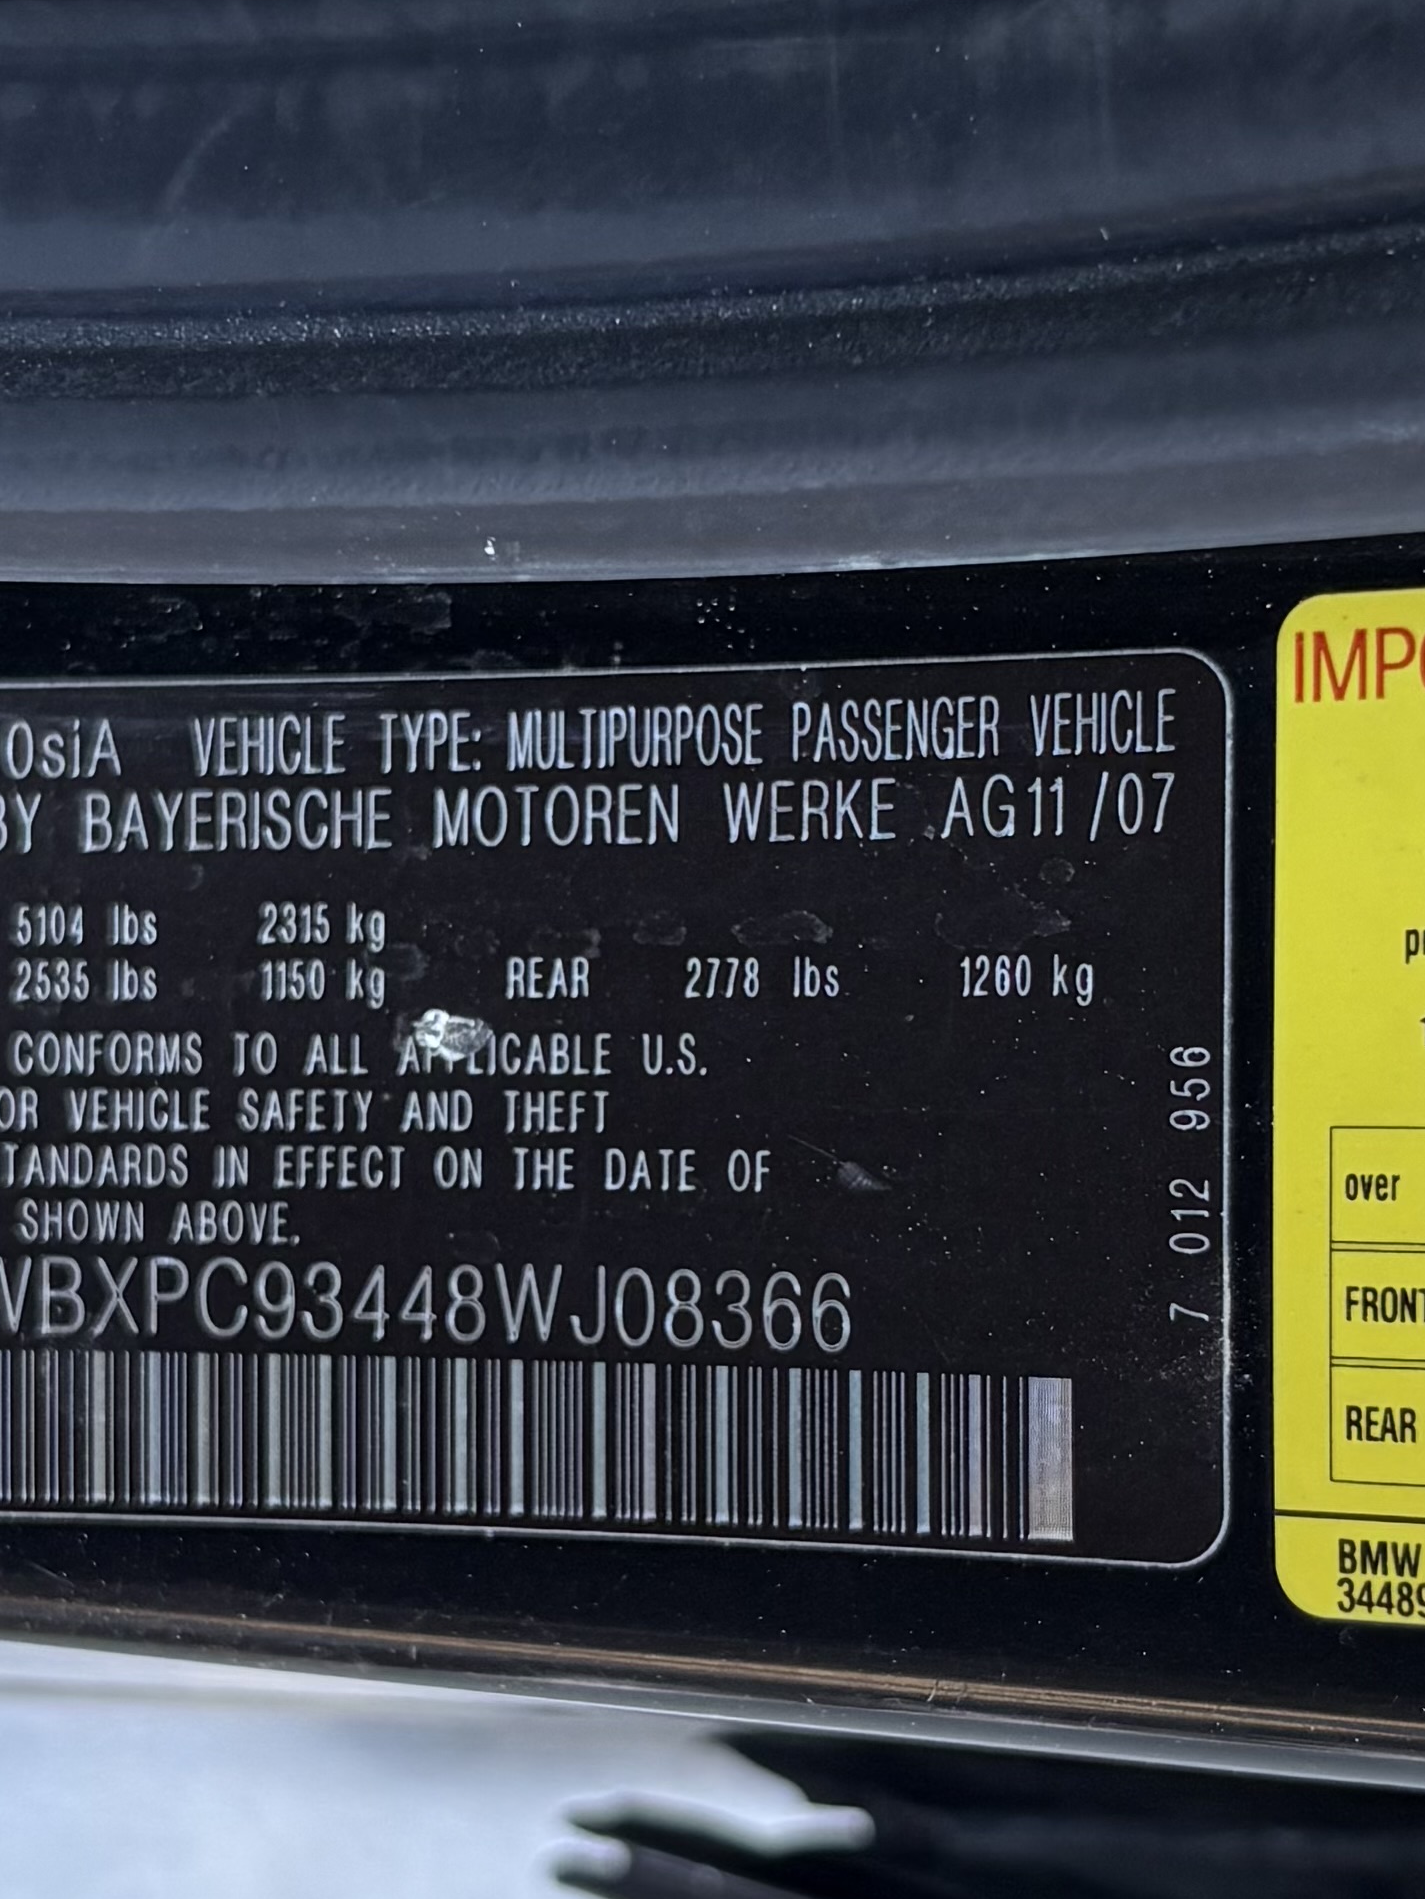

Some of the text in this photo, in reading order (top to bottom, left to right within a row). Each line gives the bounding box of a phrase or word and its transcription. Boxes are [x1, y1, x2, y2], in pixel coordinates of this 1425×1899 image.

[194, 714, 346, 777] VEHICLE
[379, 711, 481, 773] TYPE:
[508, 703, 764, 772] MULTIPURPOSE
[792, 695, 1000, 763] PASSENGER
[1030, 688, 1176, 757] VEHICLE
[83, 788, 392, 853] BAYERISCHE
[433, 783, 679, 849] MOTOREN
[723, 777, 896, 844] WERKE
[16, 905, 84, 946] 5104
[113, 904, 157, 945] lbs
[261, 903, 330, 945] 2315
[349, 902, 385, 953] kg
[15, 959, 90, 1002] 2535
[112, 960, 157, 1001] lbs
[263, 959, 325, 1001] 1150
[349, 959, 385, 1009] kg
[506, 956, 589, 1000] REAR
[684, 956, 760, 999] 2778
[793, 956, 840, 998] lbs
[960, 954, 1032, 998] 1260
[1052, 953, 1094, 1007] kg
[14, 1032, 203, 1075] CONFORMS
[235, 1032, 277, 1076] TO
[305, 1034, 369, 1076] ALL
[642, 1032, 707, 1076] U.S.
[70, 1088, 210, 1131] VEHICLE
[240, 1088, 373, 1132] SAFETY
[402, 1089, 473, 1132] AND
[504, 1090, 609, 1134] THEFT
[217, 1146, 249, 1188] IN
[275, 1145, 405, 1189] EFFECT
[435, 1146, 482, 1189] ON
[514, 1147, 574, 1191] THE
[604, 1148, 696, 1192] DATE
[727, 1148, 771, 1193] OF
[1168, 1046, 1211, 1322] 7 012 956
[1345, 1173, 1401, 1202] over
[20, 1198, 144, 1243] SHOWN
[172, 1200, 300, 1244] ABOVE.
[1346, 1405, 1417, 1444] REAR
[1337, 1537, 1423, 1579] BMW
